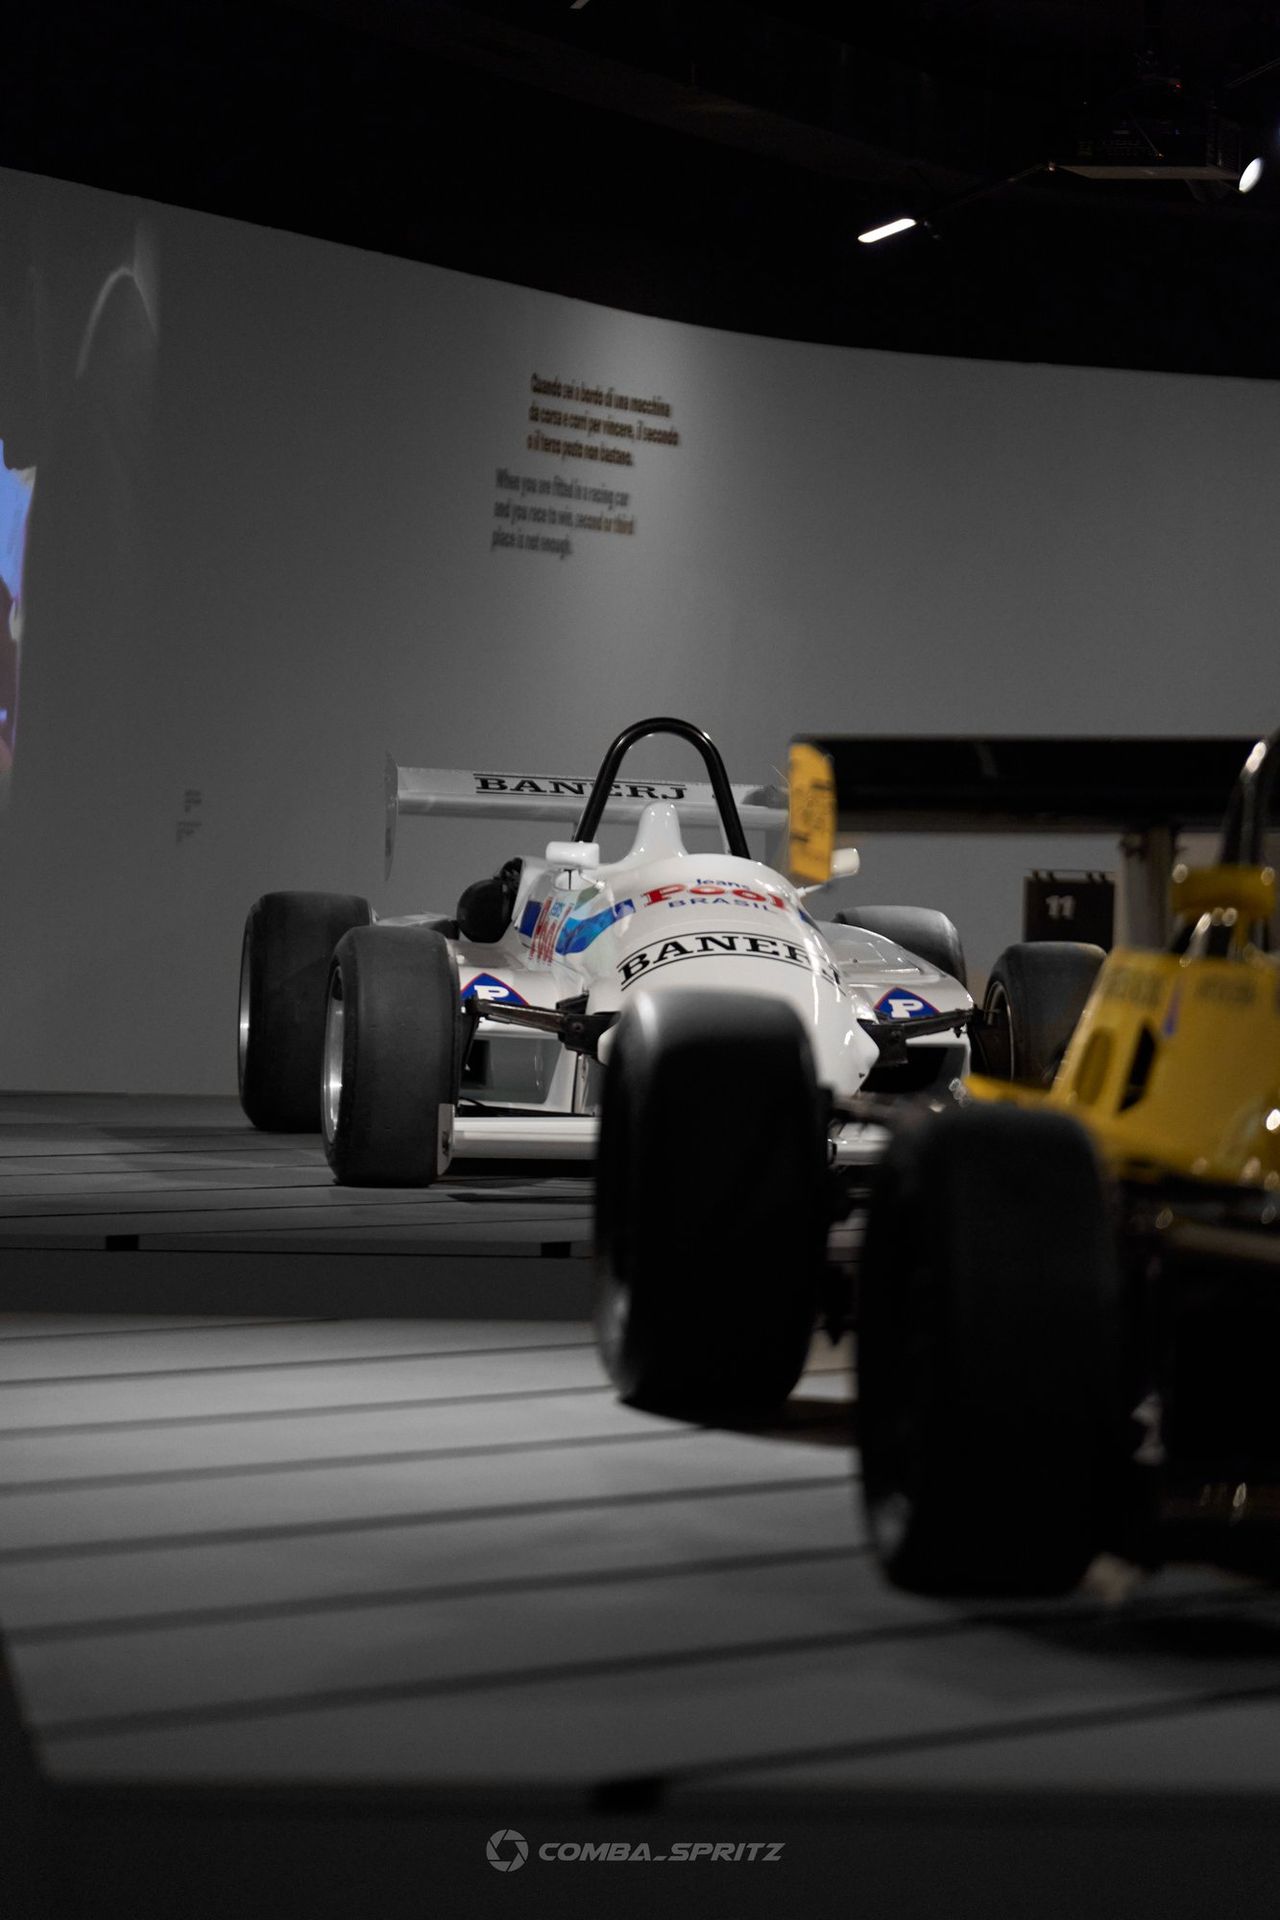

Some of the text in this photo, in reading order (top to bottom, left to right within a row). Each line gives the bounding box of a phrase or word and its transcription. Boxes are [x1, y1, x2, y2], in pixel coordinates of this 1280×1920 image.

[630, 395, 670, 418] macchina
[643, 426, 679, 446] secondo
[562, 440, 583, 460] posto
[520, 477, 537, 497] you
[588, 483, 613, 511] racing
[615, 491, 629, 507] car
[668, 896, 779, 914] BRASIL
[1045, 895, 1075, 920] 11
